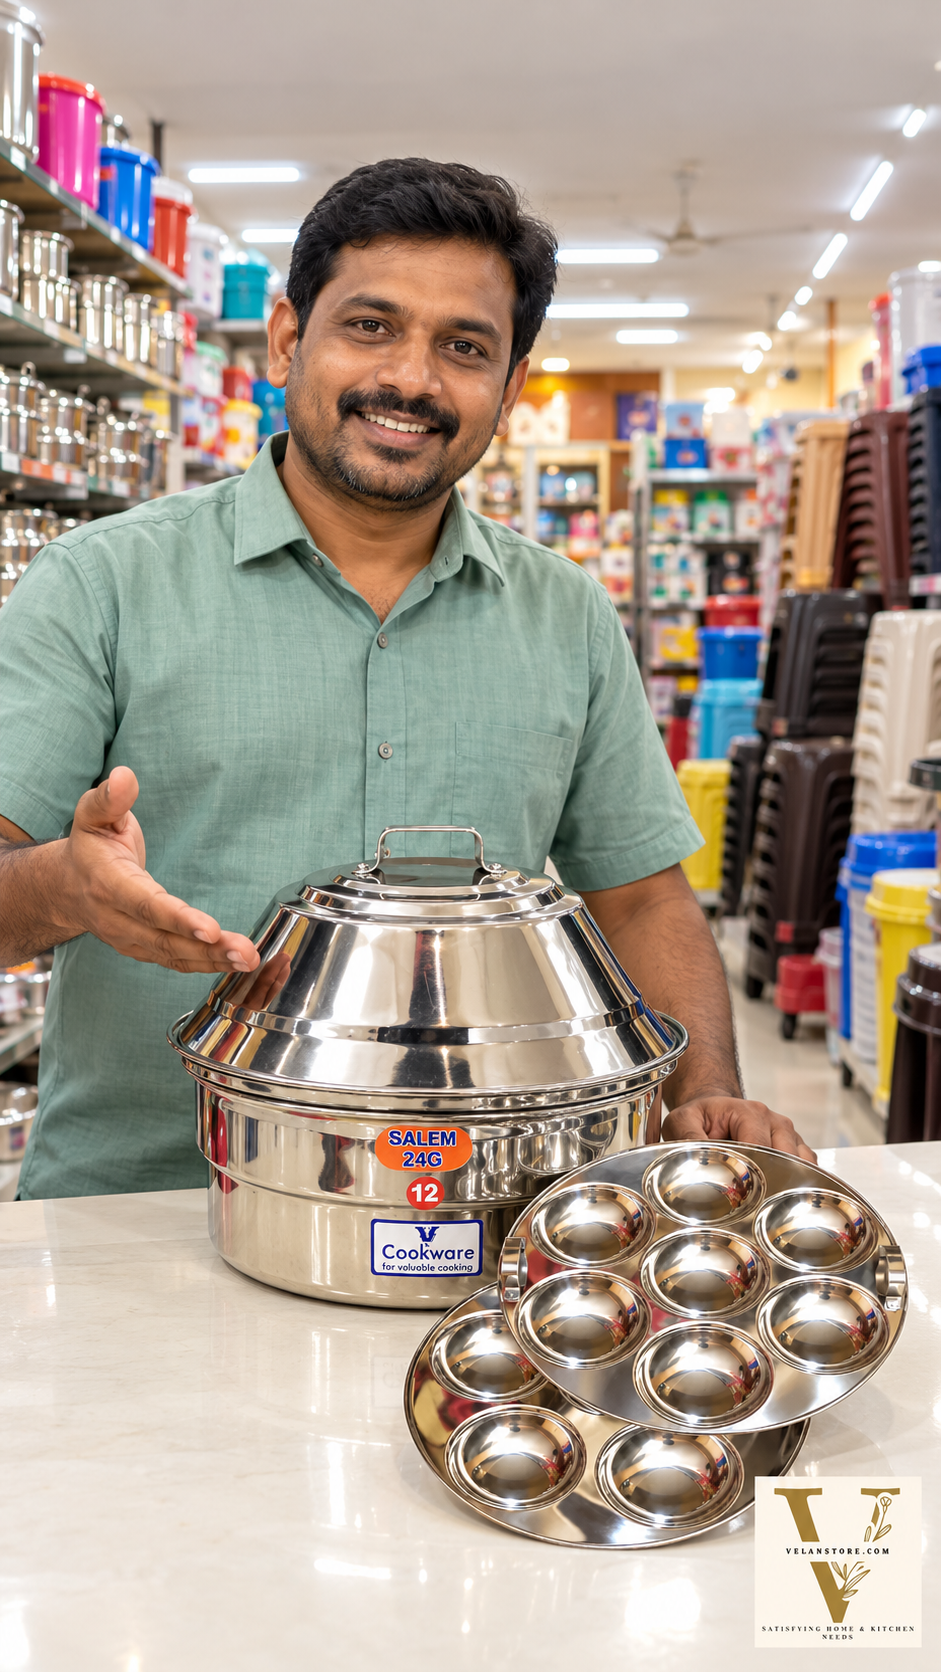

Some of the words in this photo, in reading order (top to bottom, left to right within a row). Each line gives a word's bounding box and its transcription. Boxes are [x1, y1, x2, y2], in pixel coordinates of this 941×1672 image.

[388, 1130, 457, 1147] SALEM
[402, 1151, 443, 1168] 24G
[411, 1183, 439, 1202] 12
[382, 1243, 475, 1260] Cookware
[382, 1262, 395, 1271] for
[437, 1263, 473, 1273] cooking
